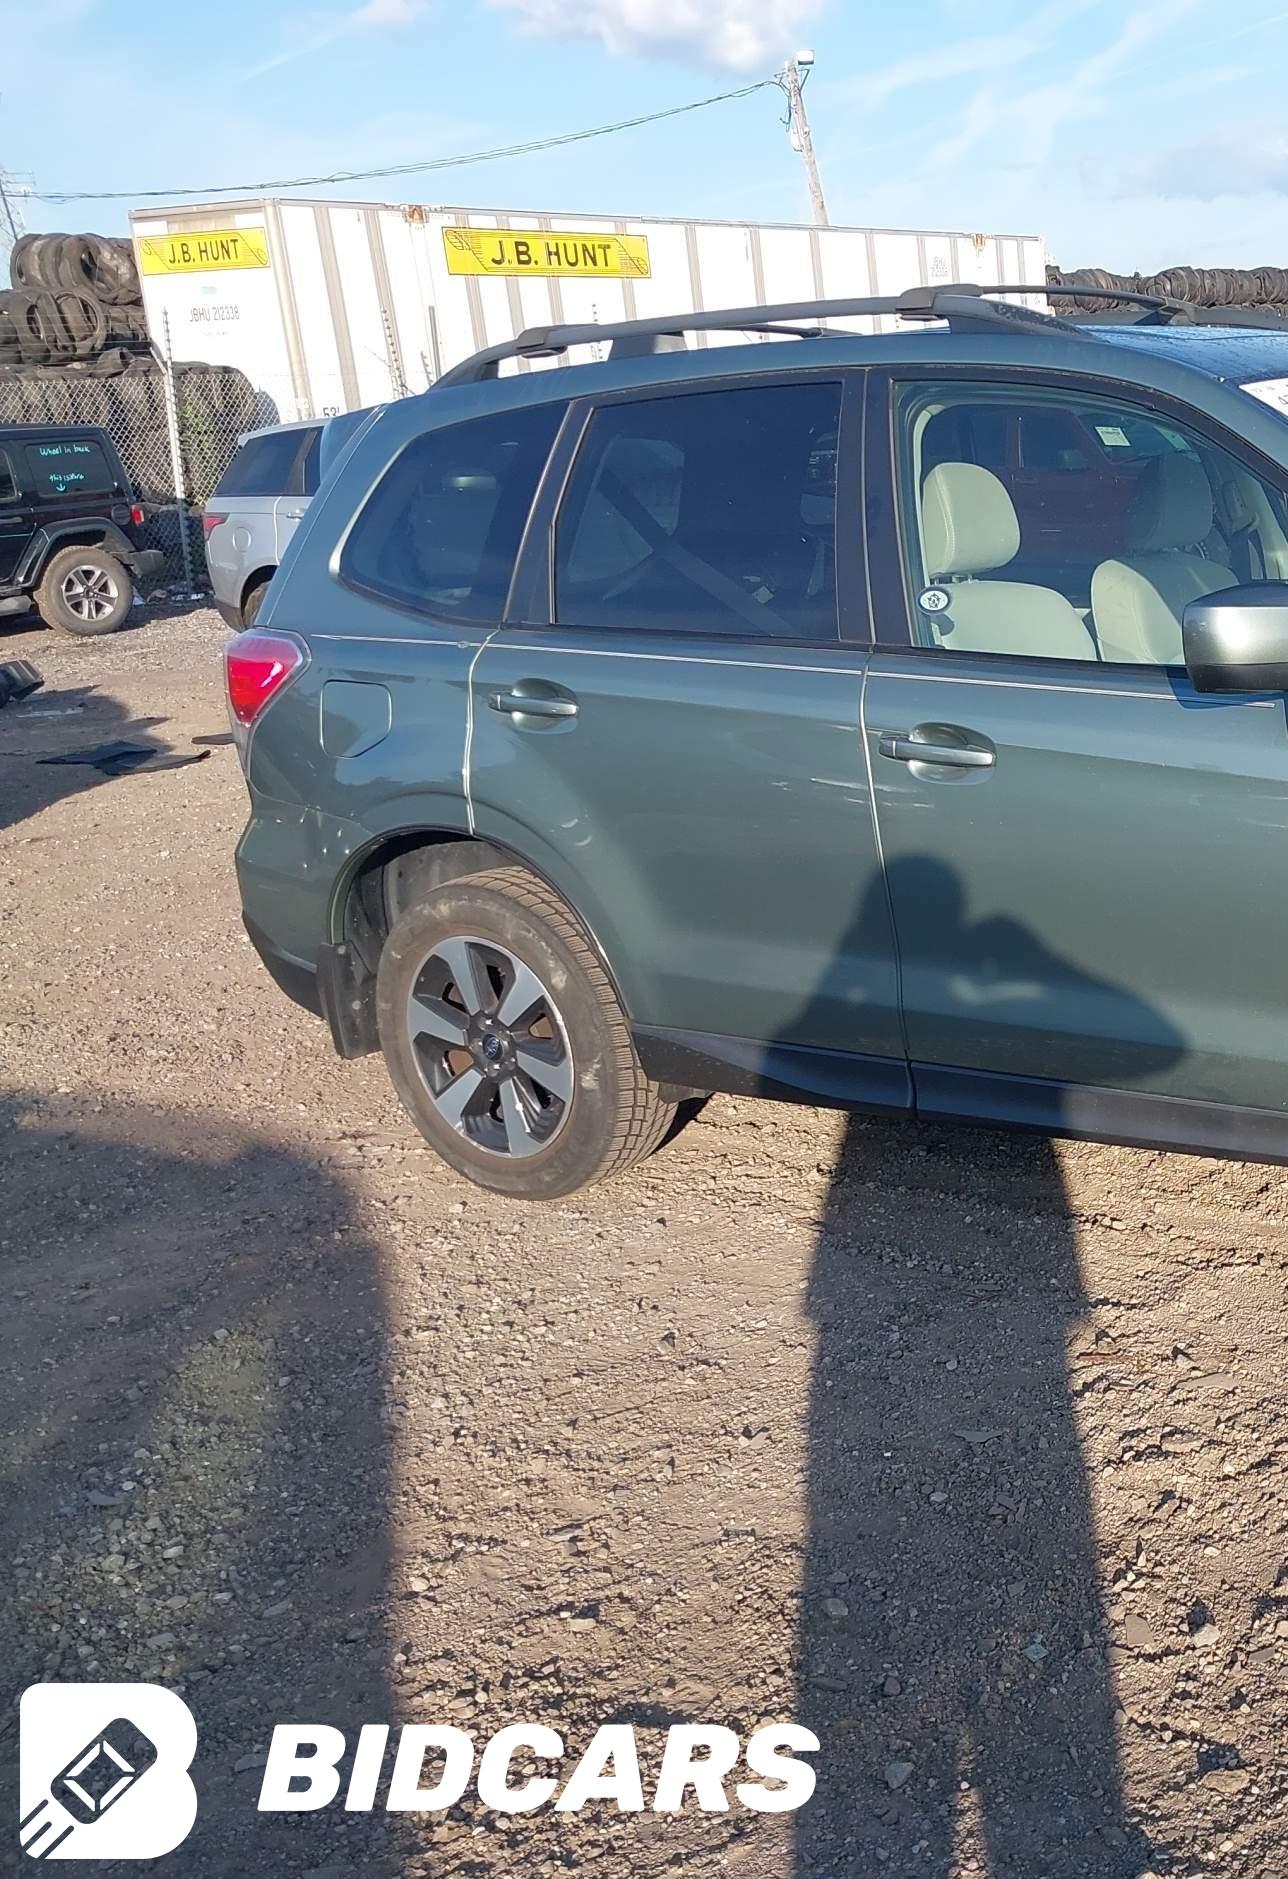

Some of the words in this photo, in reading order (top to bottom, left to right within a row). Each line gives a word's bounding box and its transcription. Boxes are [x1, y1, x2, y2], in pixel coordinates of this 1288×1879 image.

[169, 243, 195, 264] J.B.
[198, 239, 239, 262] HUNT
[491, 240, 538, 266] J.B.
[545, 242, 612, 267] HUNT
